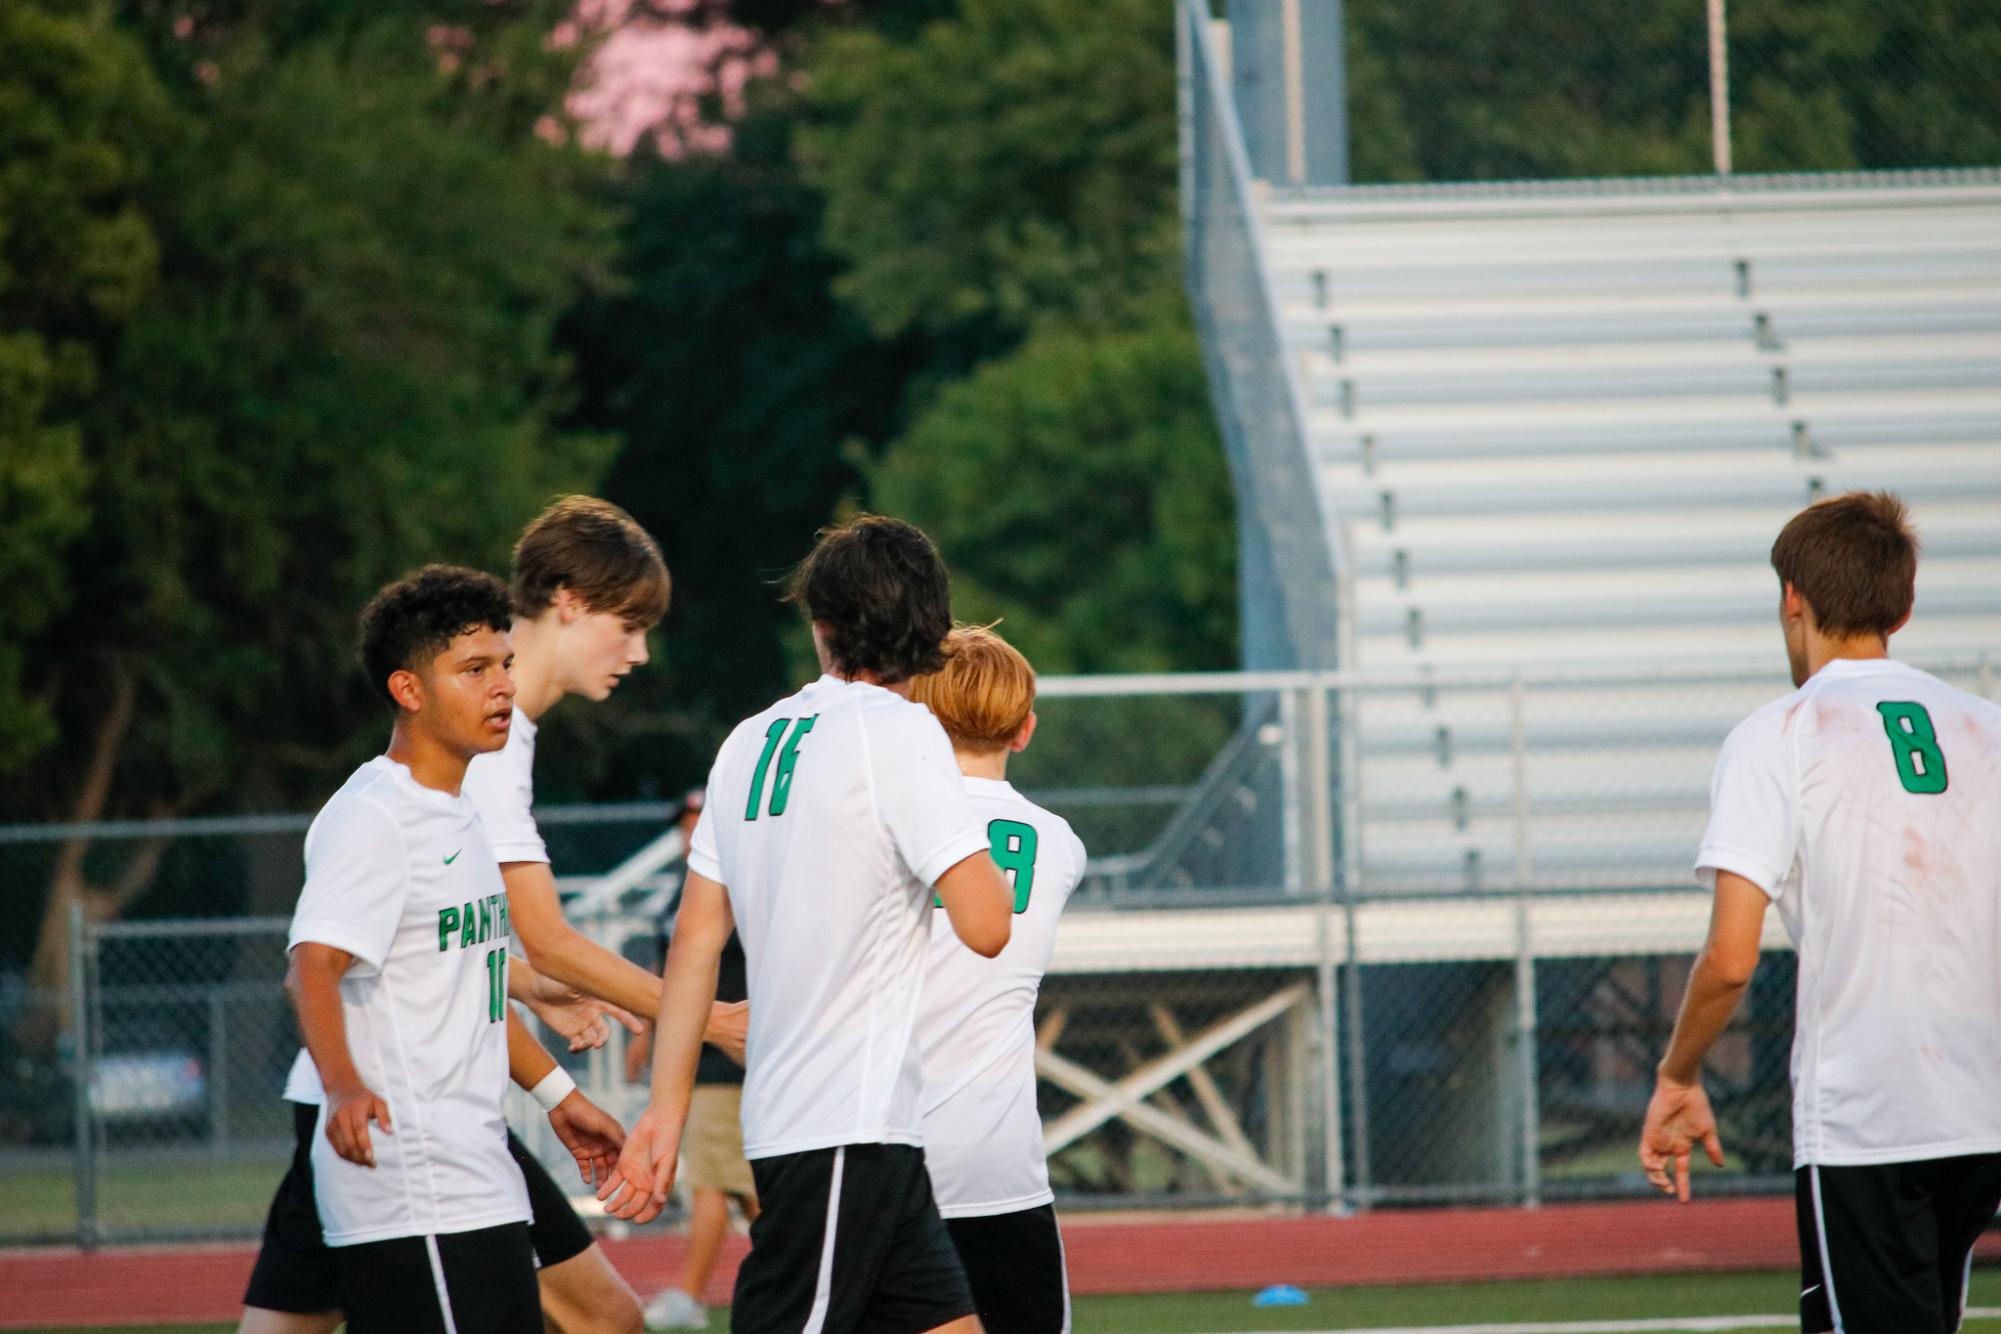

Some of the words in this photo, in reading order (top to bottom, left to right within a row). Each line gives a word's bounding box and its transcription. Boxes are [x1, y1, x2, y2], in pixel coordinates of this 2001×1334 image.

[744, 713, 820, 821] 16
[1876, 701, 1948, 794] 8
[487, 947, 506, 1024] 11
